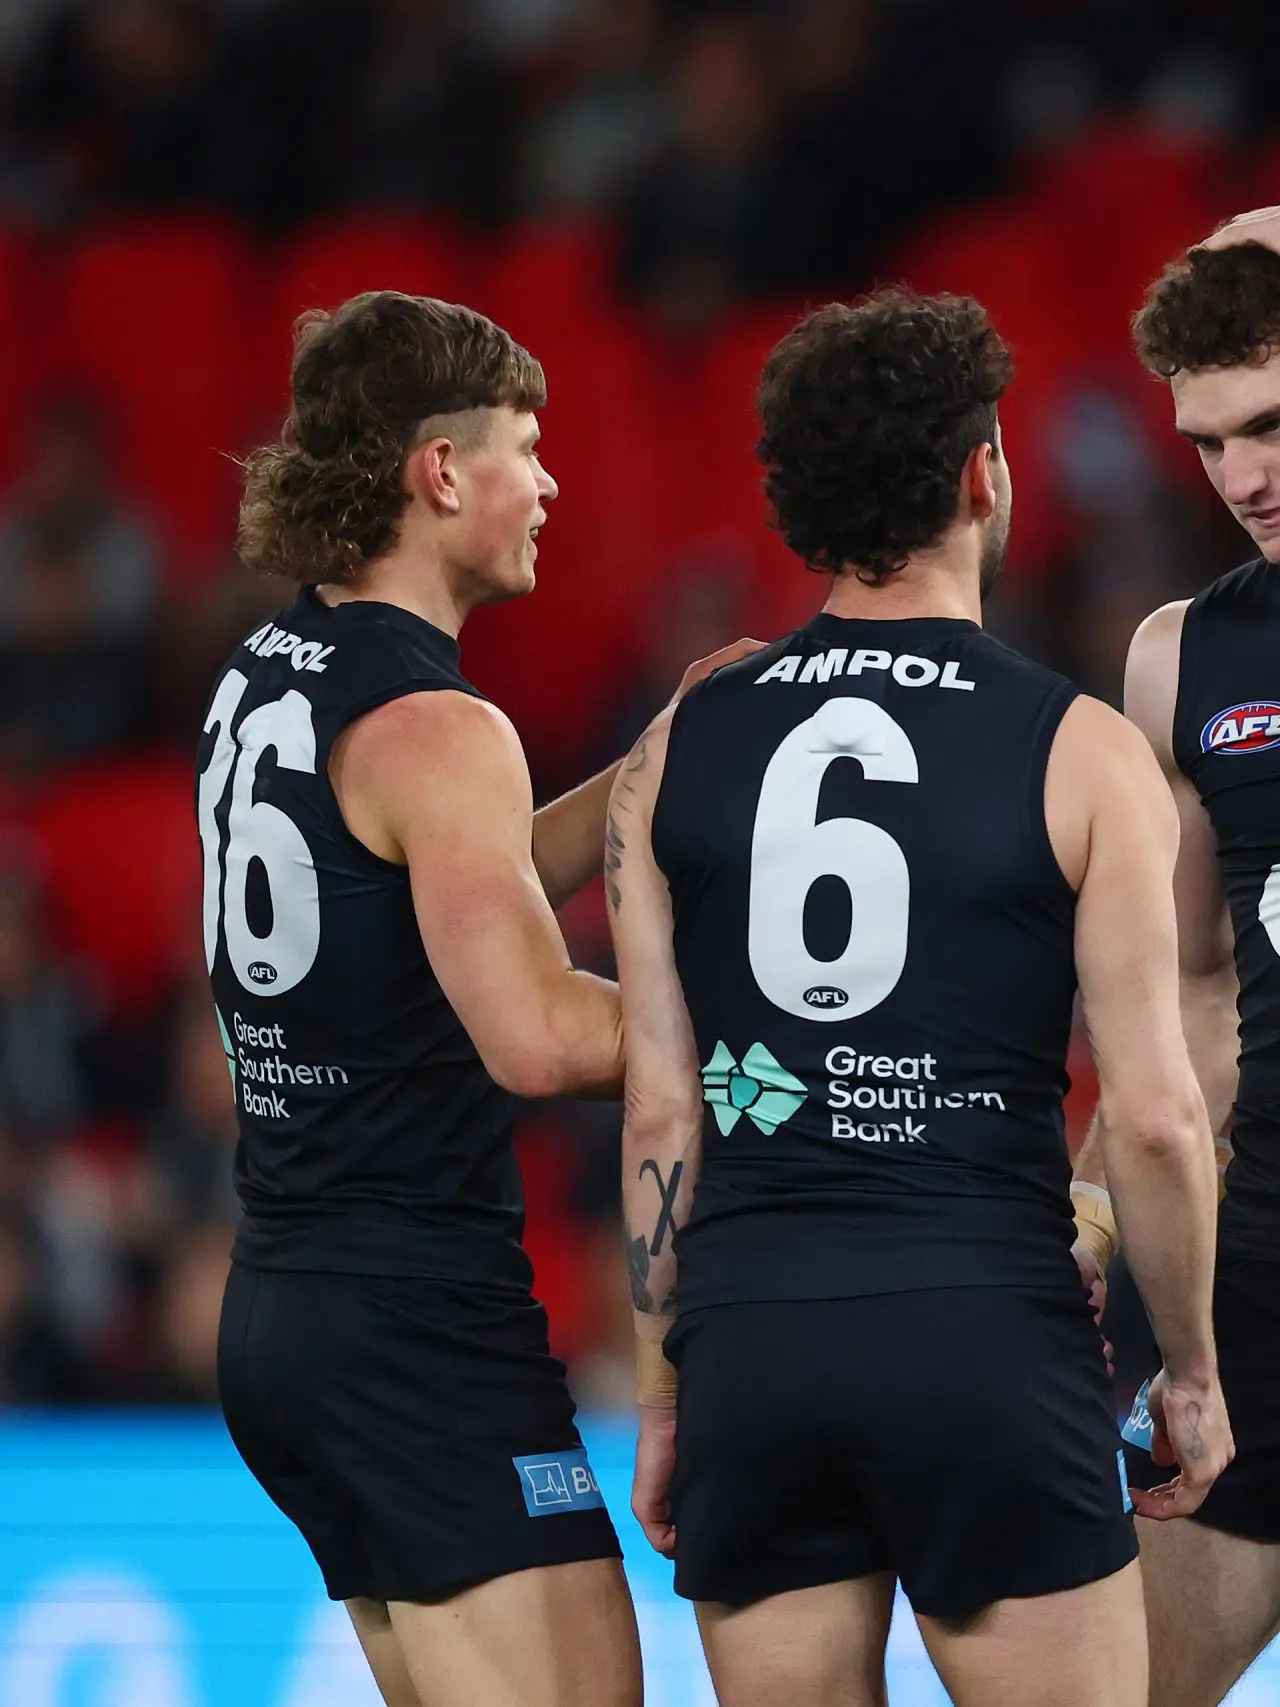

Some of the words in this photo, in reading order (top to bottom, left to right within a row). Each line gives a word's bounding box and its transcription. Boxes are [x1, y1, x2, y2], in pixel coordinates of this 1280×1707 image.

[243, 622, 336, 673] AMPOL
[754, 648, 976, 691] AMPOL
[748, 696, 919, 1022] 6
[250, 966, 276, 980] AFL
[807, 991, 846, 1004] AFL
[233, 1011, 287, 1049] Great
[238, 1047, 349, 1084] Southern
[825, 1045, 937, 1080] Great
[242, 1082, 291, 1118] Bank
[831, 1113, 928, 1143] Bank
